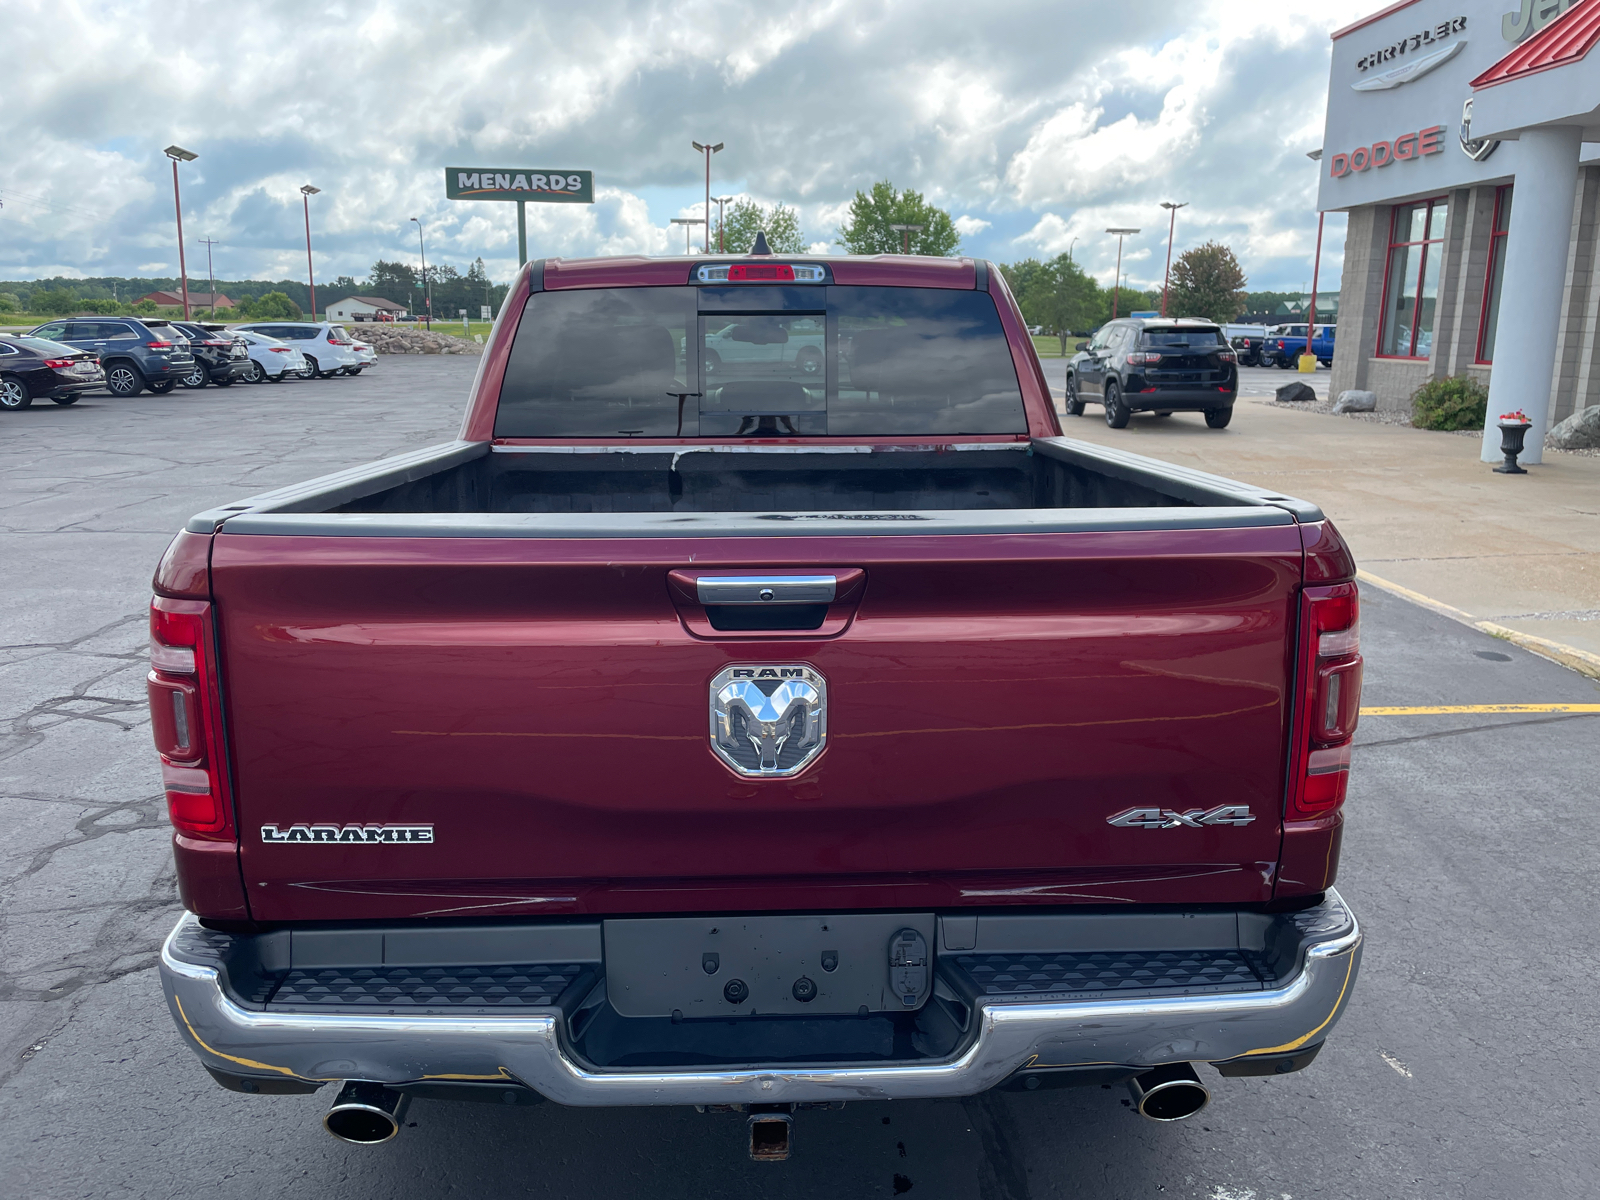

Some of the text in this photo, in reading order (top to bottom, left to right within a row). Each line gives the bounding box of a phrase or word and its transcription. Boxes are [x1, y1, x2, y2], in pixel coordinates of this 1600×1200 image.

[1355, 15, 1467, 71] CHRYSLER
[1330, 125, 1446, 178] DODGE
[458, 172, 582, 191] MENARDS
[733, 668, 803, 678] RAM
[261, 826, 434, 843] LARAMIE
